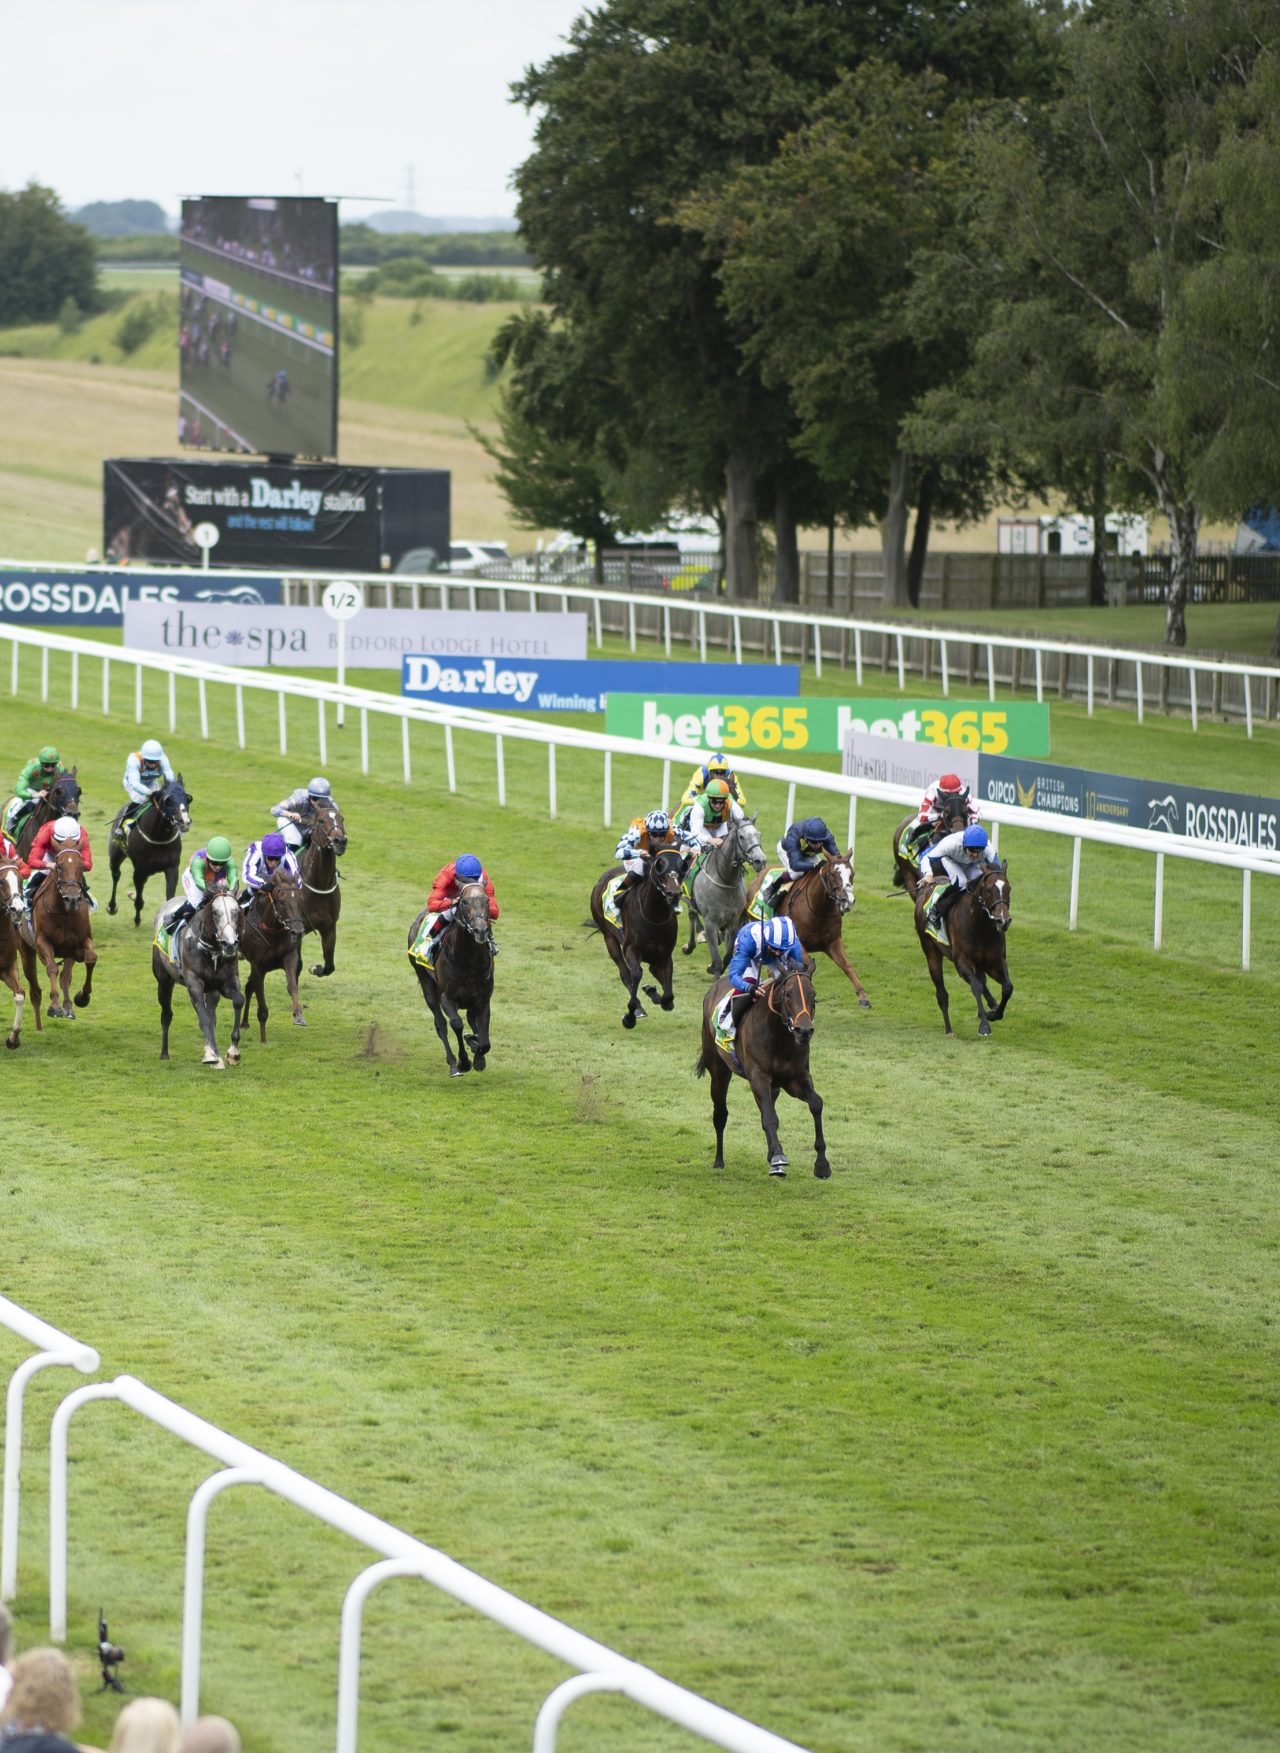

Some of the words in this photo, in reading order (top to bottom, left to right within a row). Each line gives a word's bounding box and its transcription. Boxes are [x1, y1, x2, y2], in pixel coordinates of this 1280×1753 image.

[251, 478, 322, 516] Darley
[330, 593, 356, 609] 1/2
[161, 610, 222, 649] the
[246, 626, 308, 664] spa
[328, 633, 413, 651] BDFORD
[421, 635, 481, 654] LODGE
[491, 637, 551, 656] HOTEL
[405, 656, 539, 702] Darley
[538, 693, 596, 713] Winning
[643, 701, 809, 750] bet365
[837, 705, 1009, 755] bet365
[1037, 777, 1064, 792] BRITISH
[1037, 791, 1079, 813] CHAMPIONS
[1185, 802, 1277, 850] ROSSDALES
